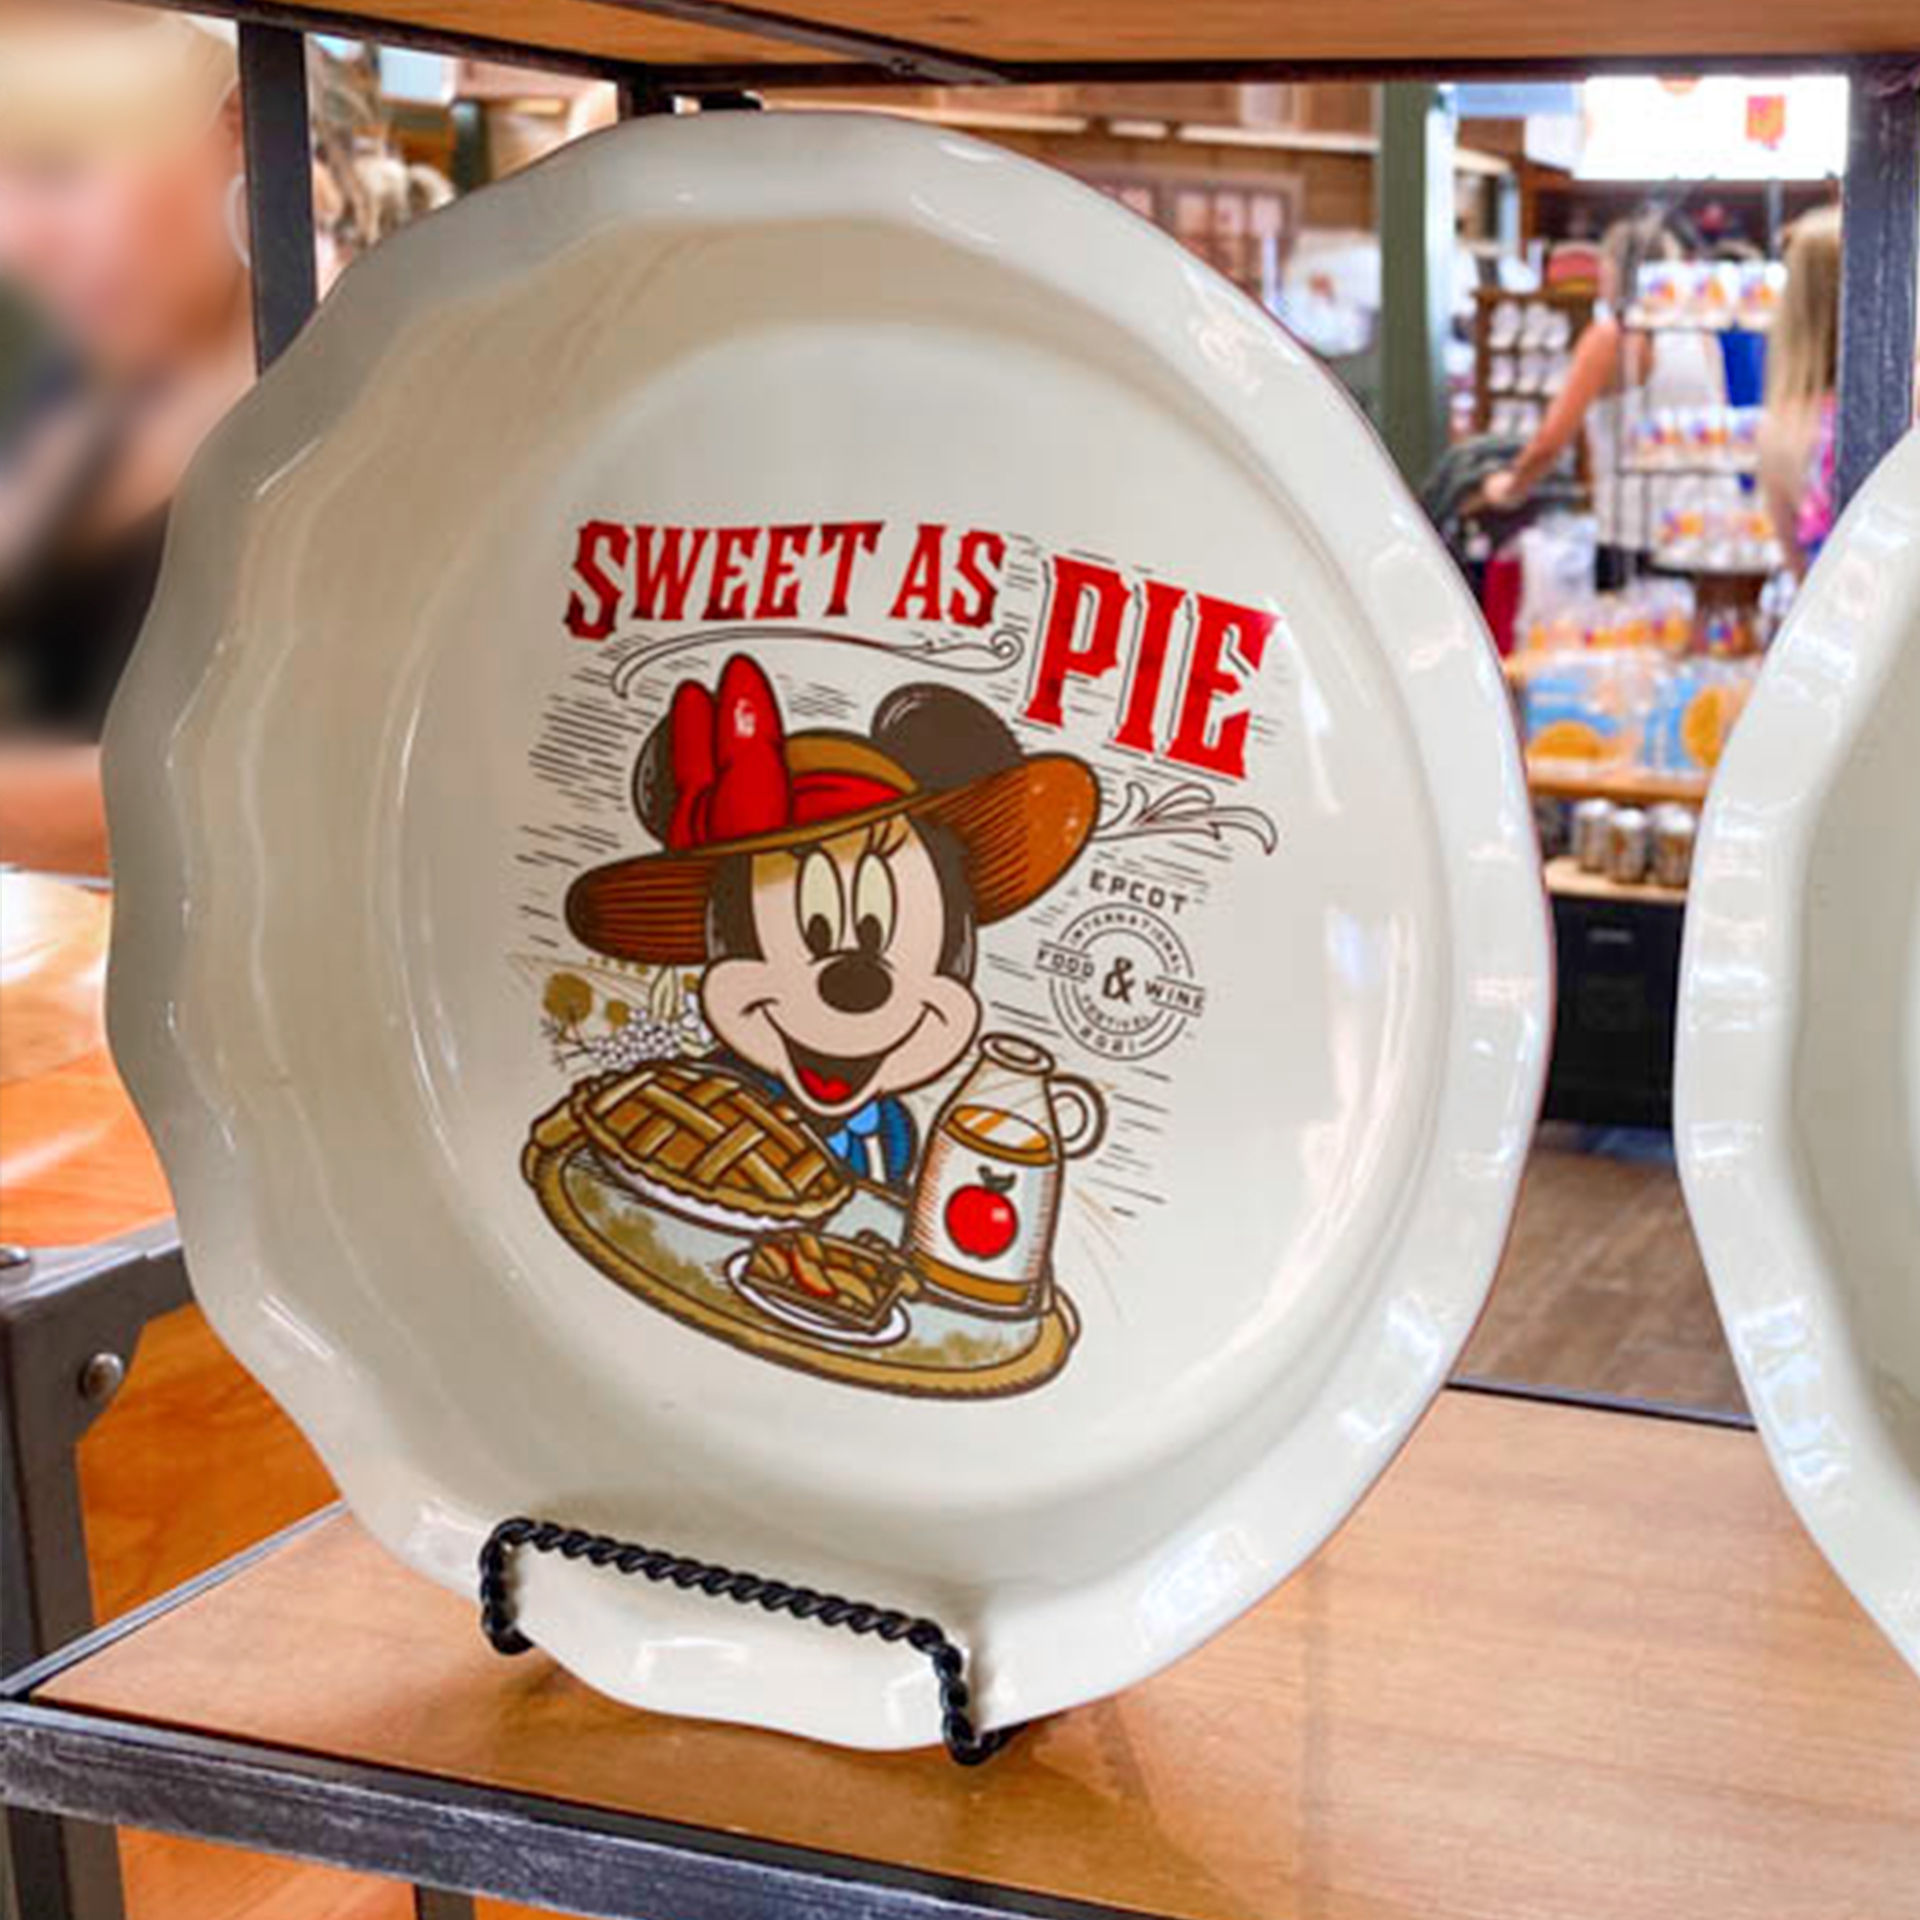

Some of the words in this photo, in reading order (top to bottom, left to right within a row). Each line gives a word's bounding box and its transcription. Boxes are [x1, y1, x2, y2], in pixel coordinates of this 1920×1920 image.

[563, 519, 885, 641] SWEET
[888, 523, 1006, 628] AS
[1022, 555, 1282, 781] PIE
[1088, 868, 1188, 915] EPCOT
[1036, 948, 1095, 978] FOOD
[1102, 955, 1136, 1004] &
[1144, 979, 1206, 1012] WINE
